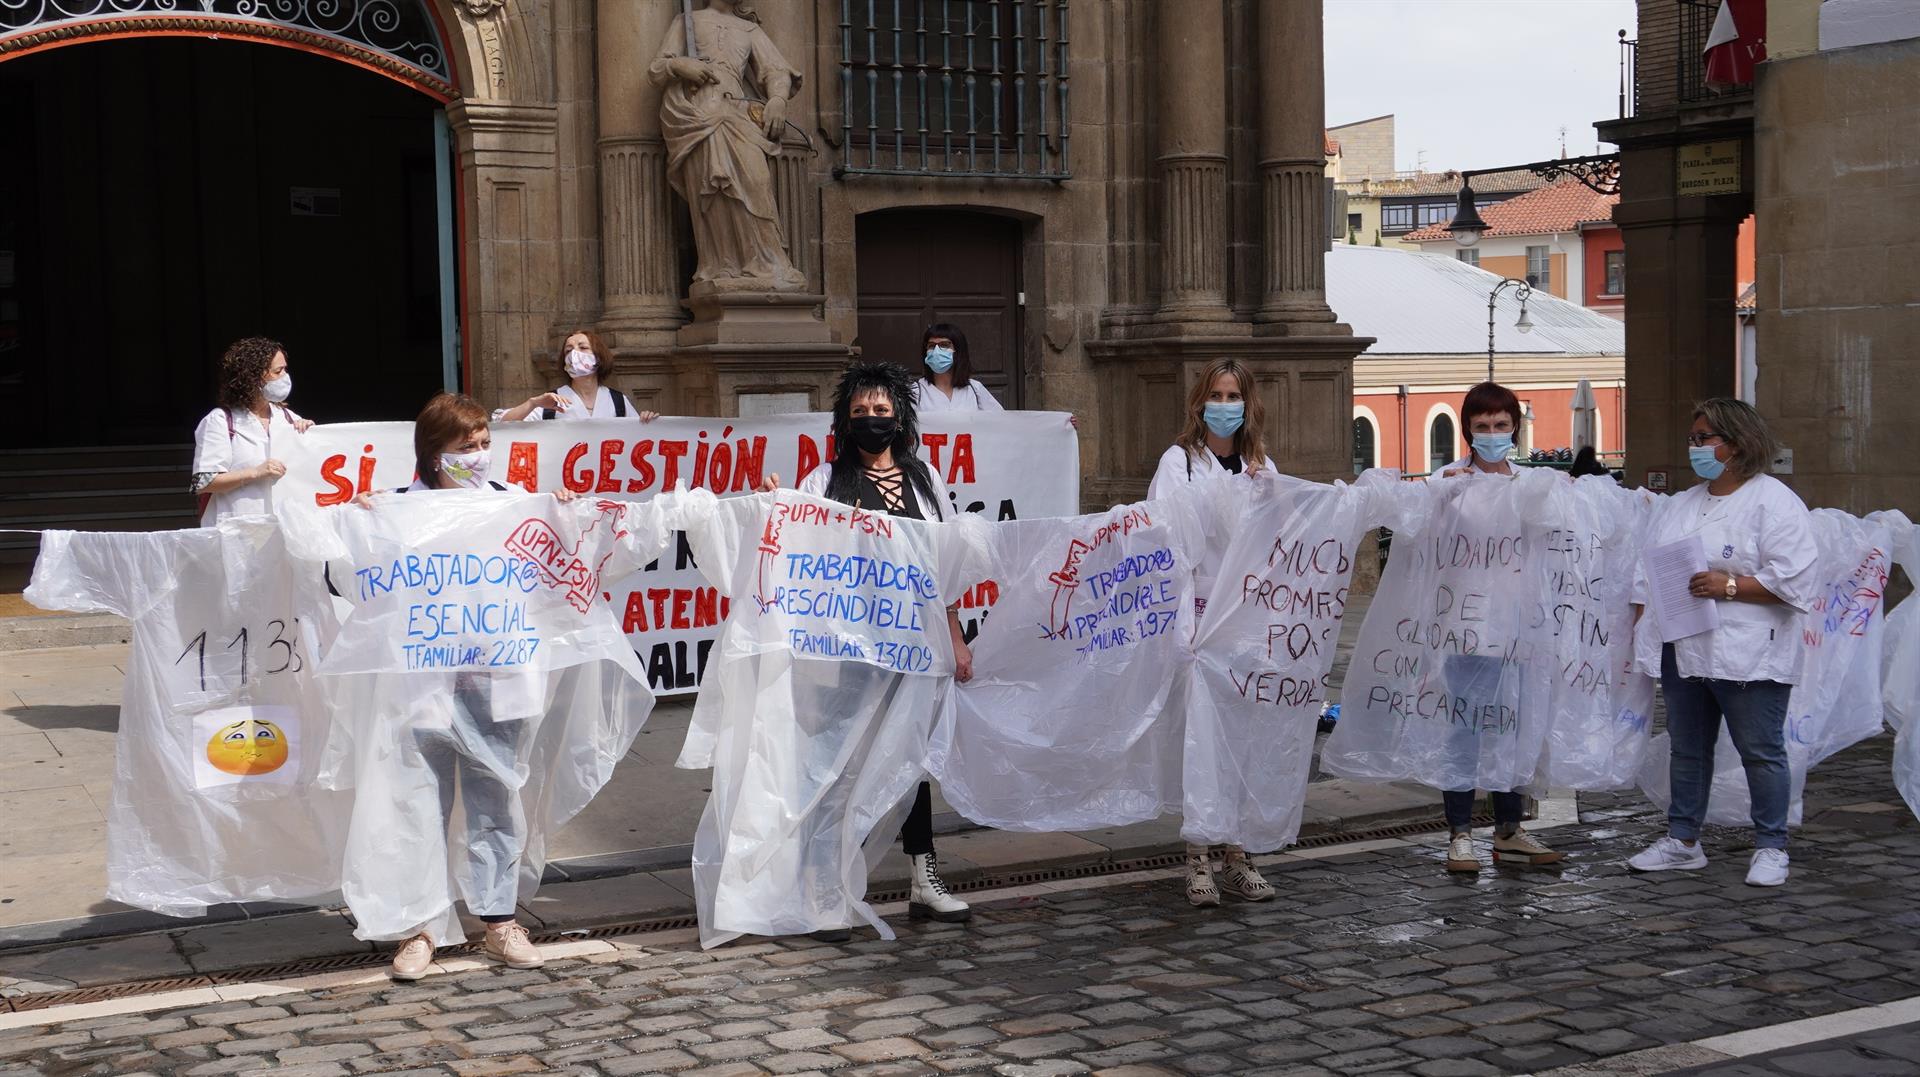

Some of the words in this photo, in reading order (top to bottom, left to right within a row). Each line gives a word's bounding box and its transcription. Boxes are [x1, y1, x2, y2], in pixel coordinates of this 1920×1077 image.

[483, 26, 505, 88] MAGIS
[790, 503, 830, 526] UPN
[850, 512, 893, 539] PSN
[355, 553, 540, 601] TRABAJADOR@
[408, 599, 535, 641] ESENCIAL
[1435, 584, 1487, 621] DE
[489, 638, 540, 667] 2287
[874, 641, 933, 672] 13009
